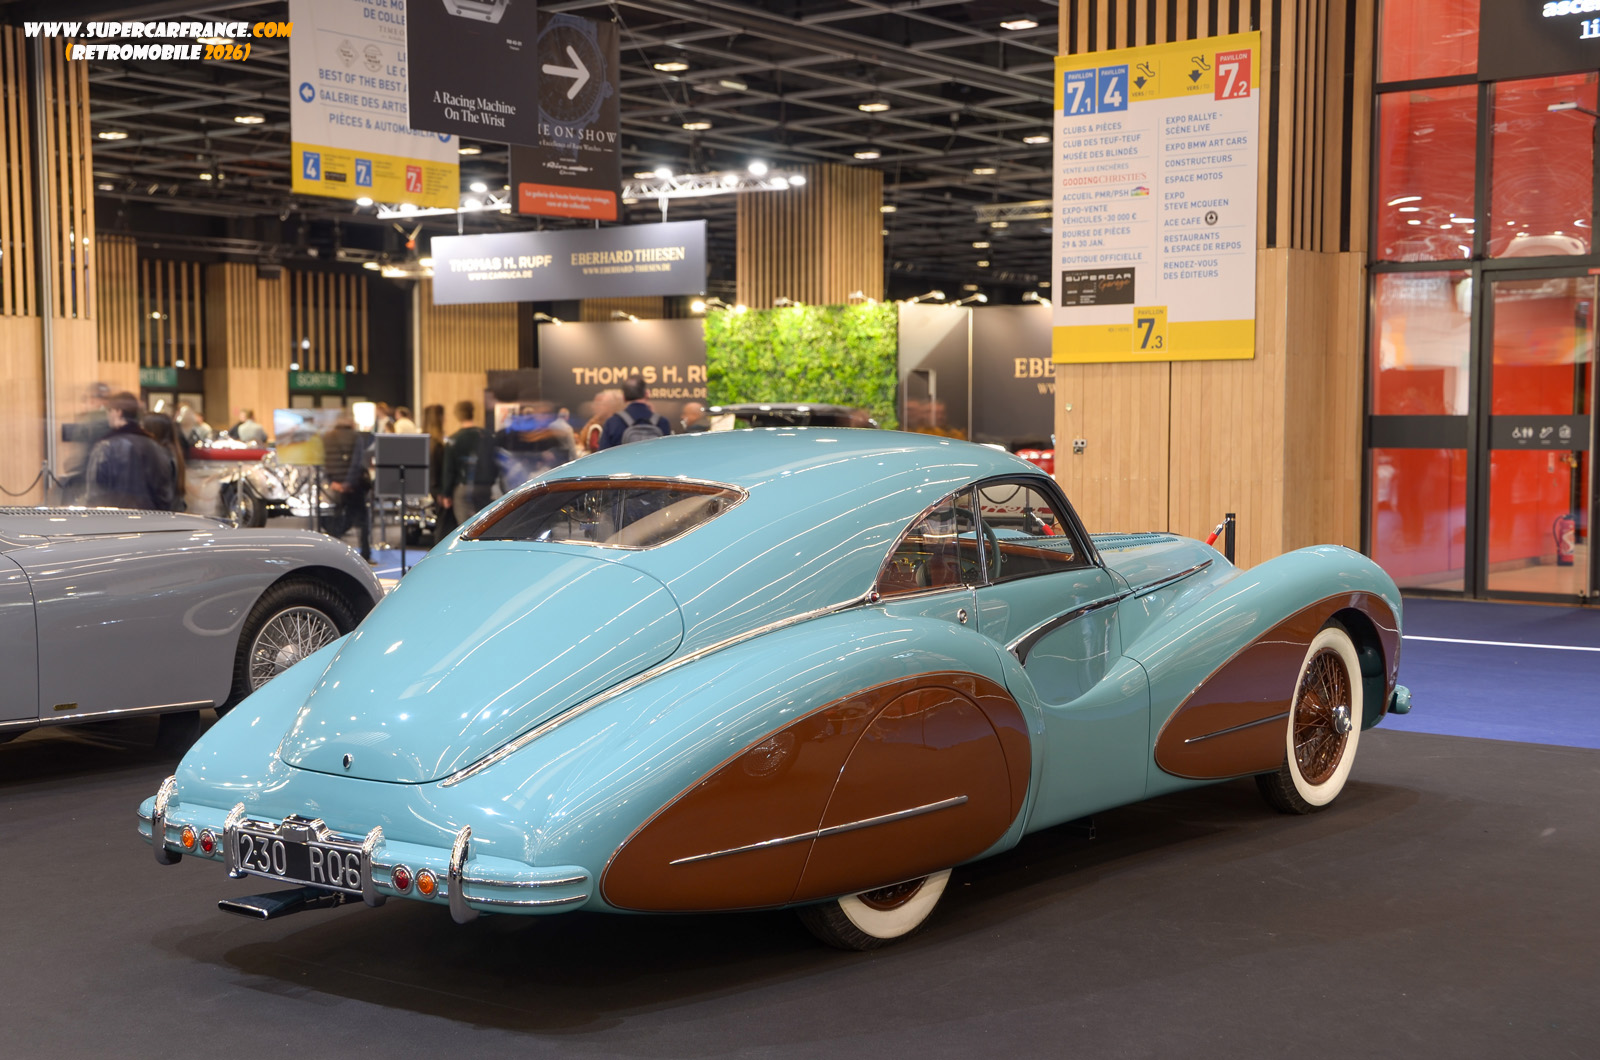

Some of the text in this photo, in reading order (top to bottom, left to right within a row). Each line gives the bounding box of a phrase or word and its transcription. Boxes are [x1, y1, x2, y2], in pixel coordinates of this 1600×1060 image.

[364, 8, 376, 20] DE
[1220, 53, 1248, 62] PAVILLON
[386, 65, 398, 76] LE
[1068, 72, 1093, 80] PAVILLON
[1101, 68, 1125, 76] PAVILLON
[319, 68, 401, 92] BEST OF THE BEST
[1218, 62, 1248, 98] 7.2
[1067, 80, 1091, 114] 7.1
[1103, 76, 1122, 107] 4
[320, 89, 359, 106] GALERIE
[361, 96, 379, 109] DES
[433, 90, 516, 115] A Racing Machine
[329, 111, 363, 128] PIÈCES
[365, 118, 372, 129] &
[444, 107, 506, 127] On The Wrist
[1166, 115, 1186, 125] EXPO
[1188, 112, 1217, 122] RALLYE
[554, 125, 574, 138] ON
[578, 128, 617, 143] SHOW
[1063, 126, 1086, 135] CLUBS
[1096, 121, 1122, 132] PIÈCES
[1165, 123, 1211, 135] SCÈNE LIVE
[1063, 133, 1141, 148] CLUB DES TEUF-TEUF
[1165, 136, 1247, 151] EXPO BMW ART CARS
[1063, 146, 1138, 160] MUSÉE DES BLINDÉS
[1096, 162, 1129, 172] ENCHÈRES
[1165, 154, 1233, 168] CONSTRUCTEURS
[305, 158, 317, 178] 4
[1165, 172, 1223, 184] ESPACE MOTOS
[1063, 189, 1129, 201] ACCUEIL PMR/PSH
[1164, 191, 1185, 200] EXPO
[1062, 204, 1108, 215] EXPO-VENTE
[1164, 198, 1229, 211] STEVE MCQUEEN
[1062, 215, 1102, 225] VÉHICULES
[1131, 212, 1136, 220] €
[1164, 216, 1201, 227] ACE CAFE
[1062, 226, 1131, 239] BOURSE DE PIÈCES
[1164, 232, 1220, 243] RESTAURANTS
[1072, 240, 1077, 248] &
[1089, 239, 1104, 247] JAN.
[1171, 243, 1201, 253] ESPACE
[1203, 242, 1213, 251] DE
[1215, 241, 1242, 250] REPOS
[571, 246, 685, 266] EBERHARD THIESEN
[1062, 252, 1142, 264] BOUTIQUE OFFICIELLE
[449, 254, 553, 272] THOMAS H. RUPF
[1163, 259, 1218, 269] RENDEZ-VOUS
[1065, 273, 1132, 282] SUPERCAR
[1163, 269, 1219, 280] DES ÉDITEURS
[1137, 318, 1163, 350] 7.3
[1014, 357, 1056, 378] EBE
[296, 373, 338, 387] SORTIE
[662, 365, 683, 384] H.
[240, 833, 287, 876] 230
